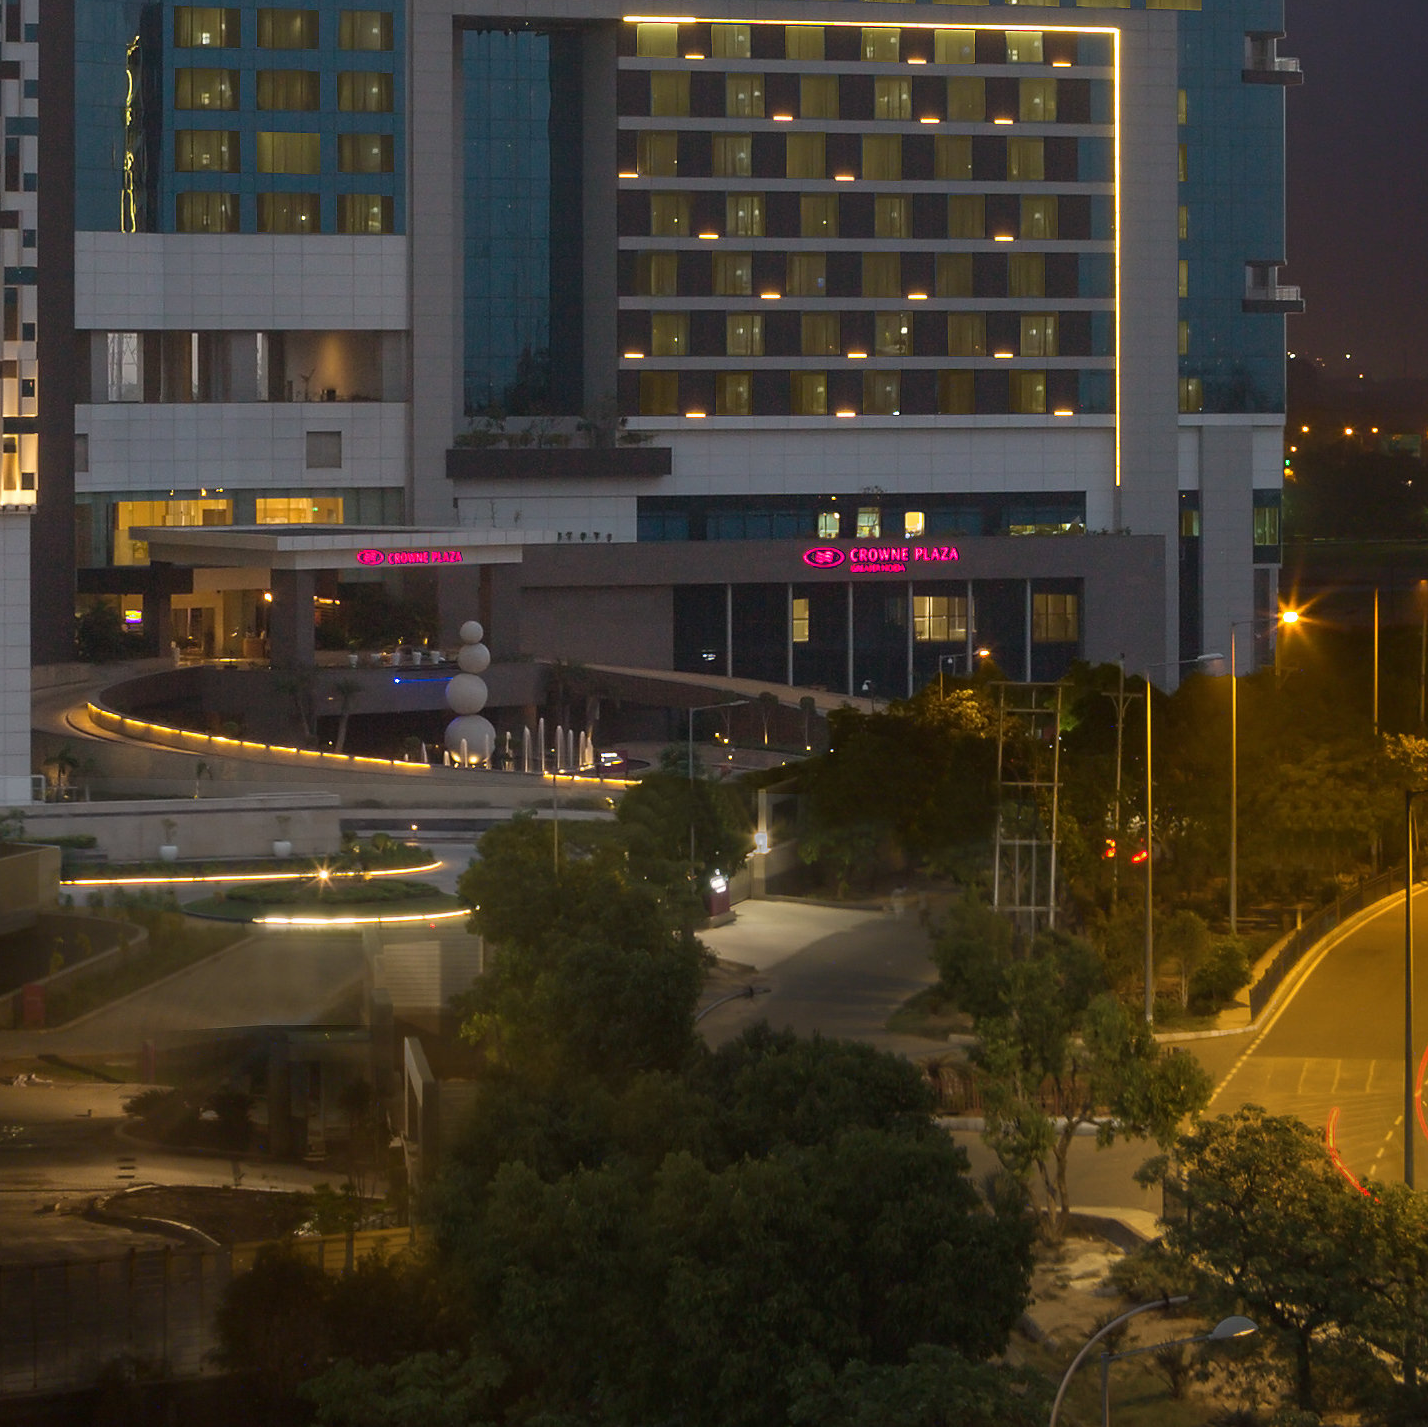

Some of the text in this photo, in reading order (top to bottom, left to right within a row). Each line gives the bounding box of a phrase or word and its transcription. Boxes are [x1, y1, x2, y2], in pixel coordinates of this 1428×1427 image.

[387, 551, 463, 565] CROWNE PLAZA
[849, 546, 959, 562] CROWNE PLAZA
